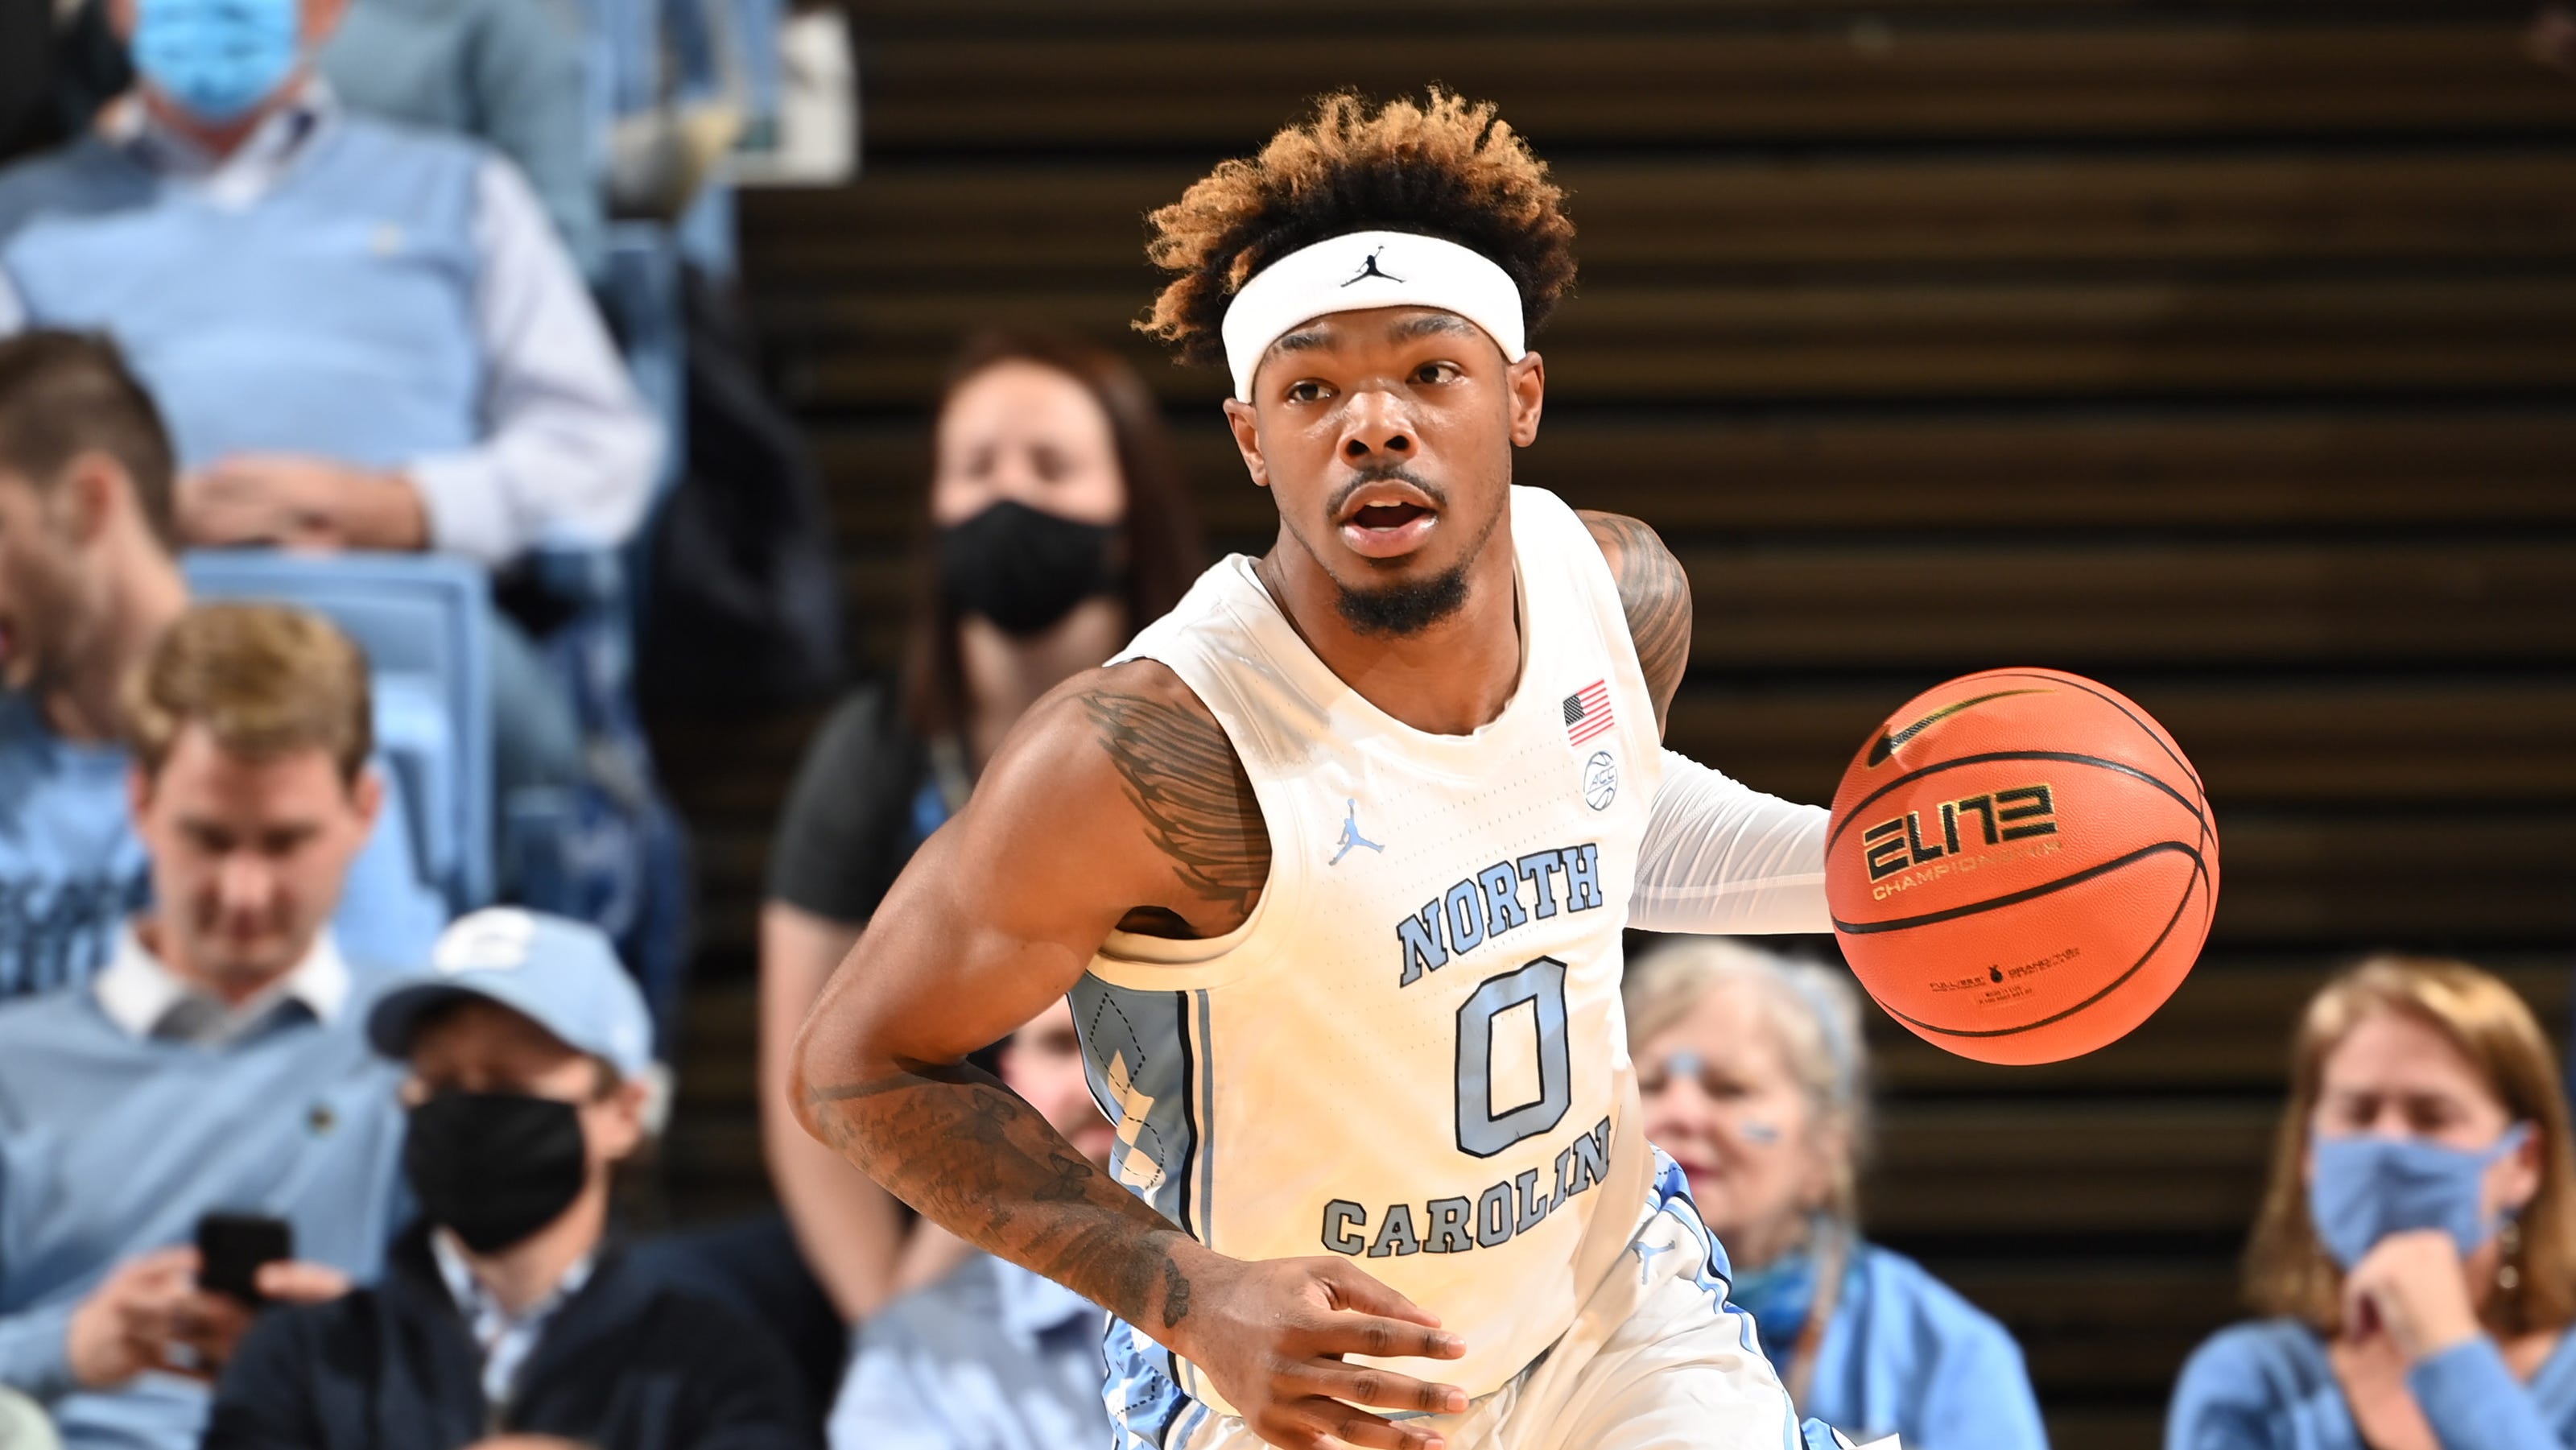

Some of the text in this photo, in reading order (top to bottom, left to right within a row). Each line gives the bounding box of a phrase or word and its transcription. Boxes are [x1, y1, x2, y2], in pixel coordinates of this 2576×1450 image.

[1589, 765, 1615, 791] ACC
[1864, 783, 2058, 883] ELITE
[1397, 842, 1603, 989] NORTH
[1455, 955, 1571, 1159] 0
[1321, 1115, 1612, 1258] CAROLIN
